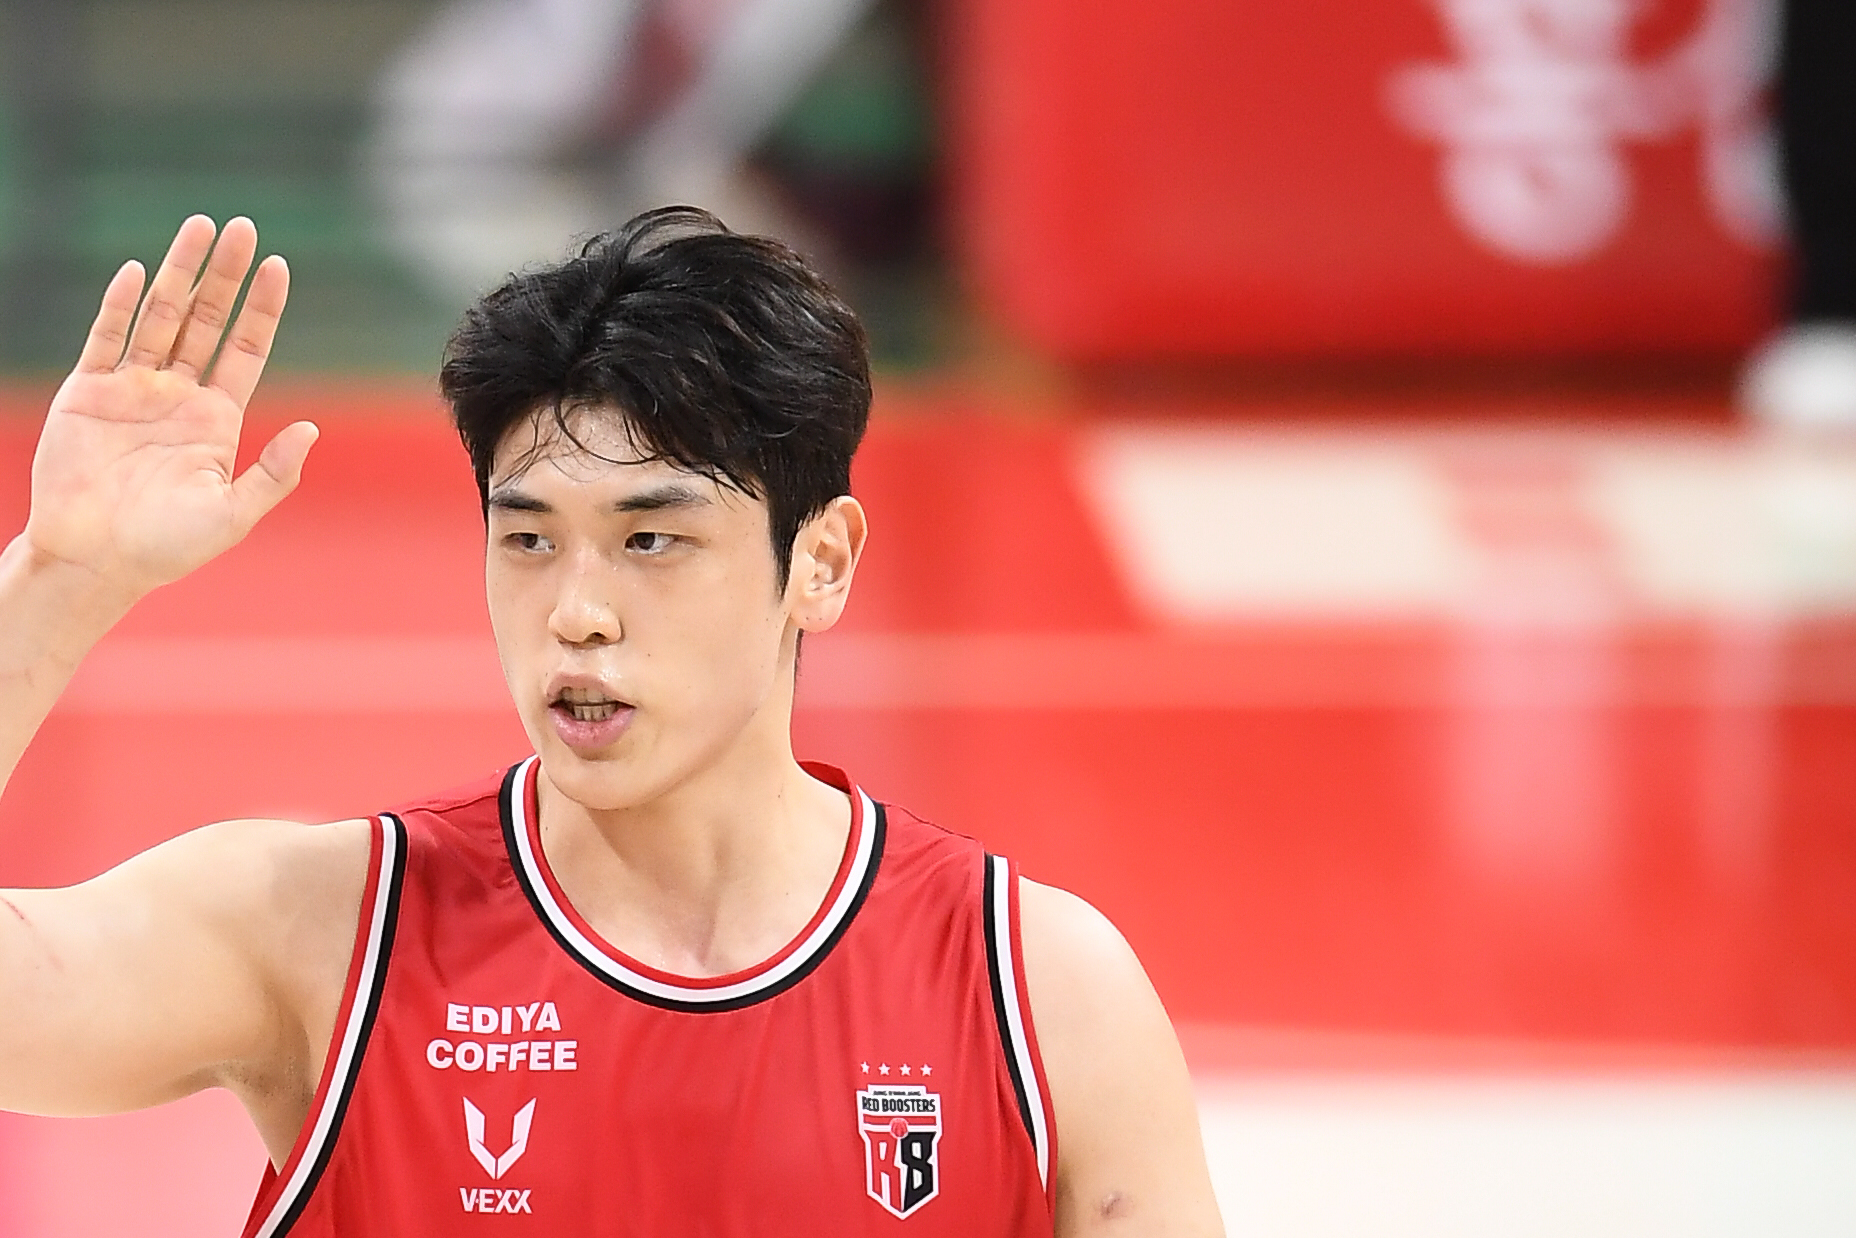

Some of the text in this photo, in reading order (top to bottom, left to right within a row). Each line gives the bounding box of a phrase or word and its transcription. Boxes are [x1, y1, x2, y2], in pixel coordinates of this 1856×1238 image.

[446, 1001, 562, 1035] EDIYA
[426, 1039, 578, 1073] COFFEE
[862, 1096, 936, 1112] RED BOOSTERS
[459, 1187, 532, 1214] VEXX
